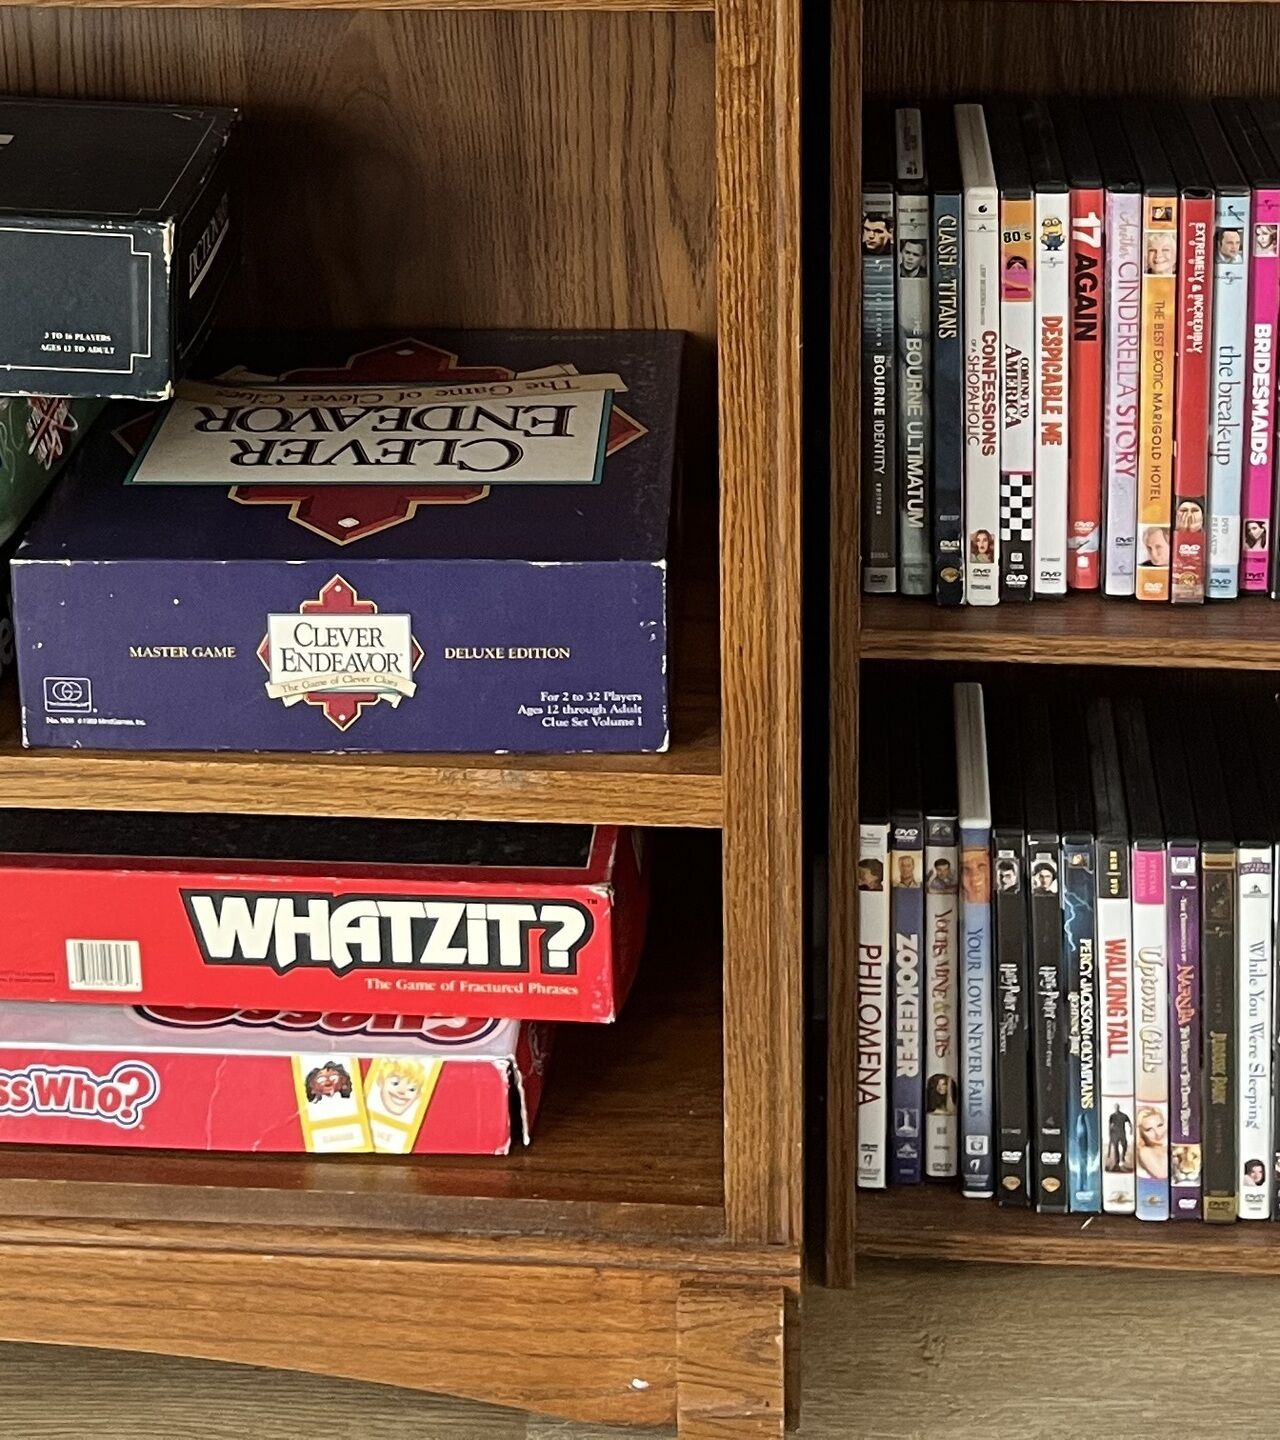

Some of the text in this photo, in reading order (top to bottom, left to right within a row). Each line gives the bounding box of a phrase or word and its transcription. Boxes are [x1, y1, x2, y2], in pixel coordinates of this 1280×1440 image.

[1072, 212, 1099, 342] 17 AGAIN
[1041, 316, 1062, 445] DESPICABLE ME
[1114, 261, 1139, 478] CINDERELLA STORY
[1250, 323, 1271, 465] BRIDESMAIDS
[904, 337, 924, 528] BOURNE ULTIMATUM
[1149, 393, 1163, 501] MARIGOLD HOTEL
[129, 646, 236, 659] MASTER GAME
[280, 648, 401, 673] ENDEAVOR
[293, 622, 384, 648] CLEVER
[444, 648, 570, 658] DELUXE EDITION
[190, 895, 588, 968] WHATZIT?
[366, 978, 578, 995] The Game of Fractured Phrases
[858, 944, 882, 1107] PHILOMENA
[896, 933, 919, 1077] ZOOKEEPER
[1105, 939, 1128, 1058] WALKING TALL
[1244, 940, 1266, 1129] While You Were Sleeping
